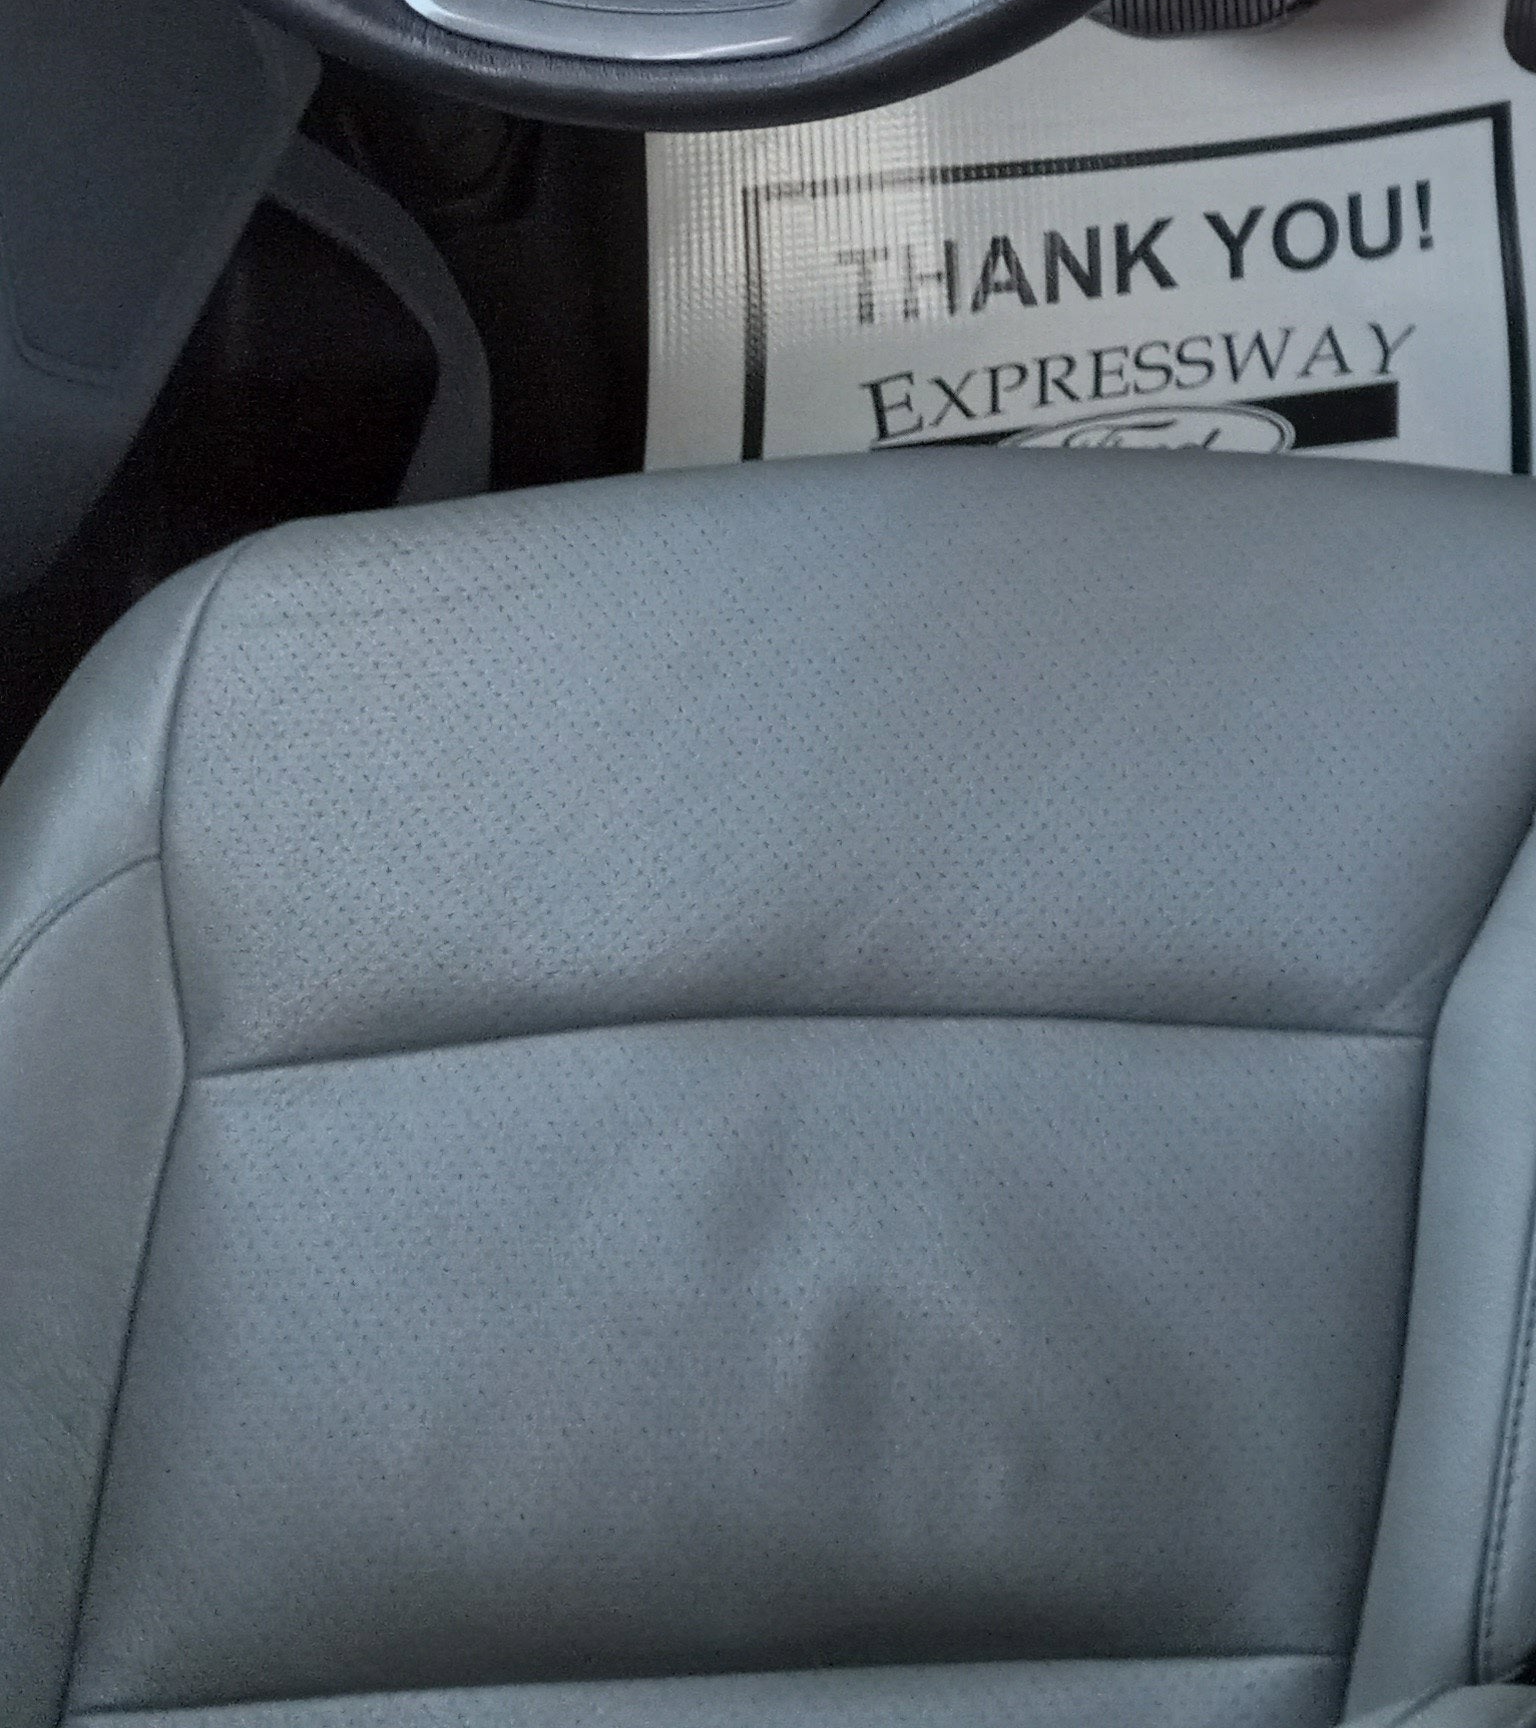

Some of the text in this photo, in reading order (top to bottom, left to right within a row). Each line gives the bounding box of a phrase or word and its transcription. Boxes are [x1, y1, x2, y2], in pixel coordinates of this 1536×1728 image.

[838, 179, 1434, 325] THANK YOU!
[859, 322, 1417, 443] EXPRESSWAY
